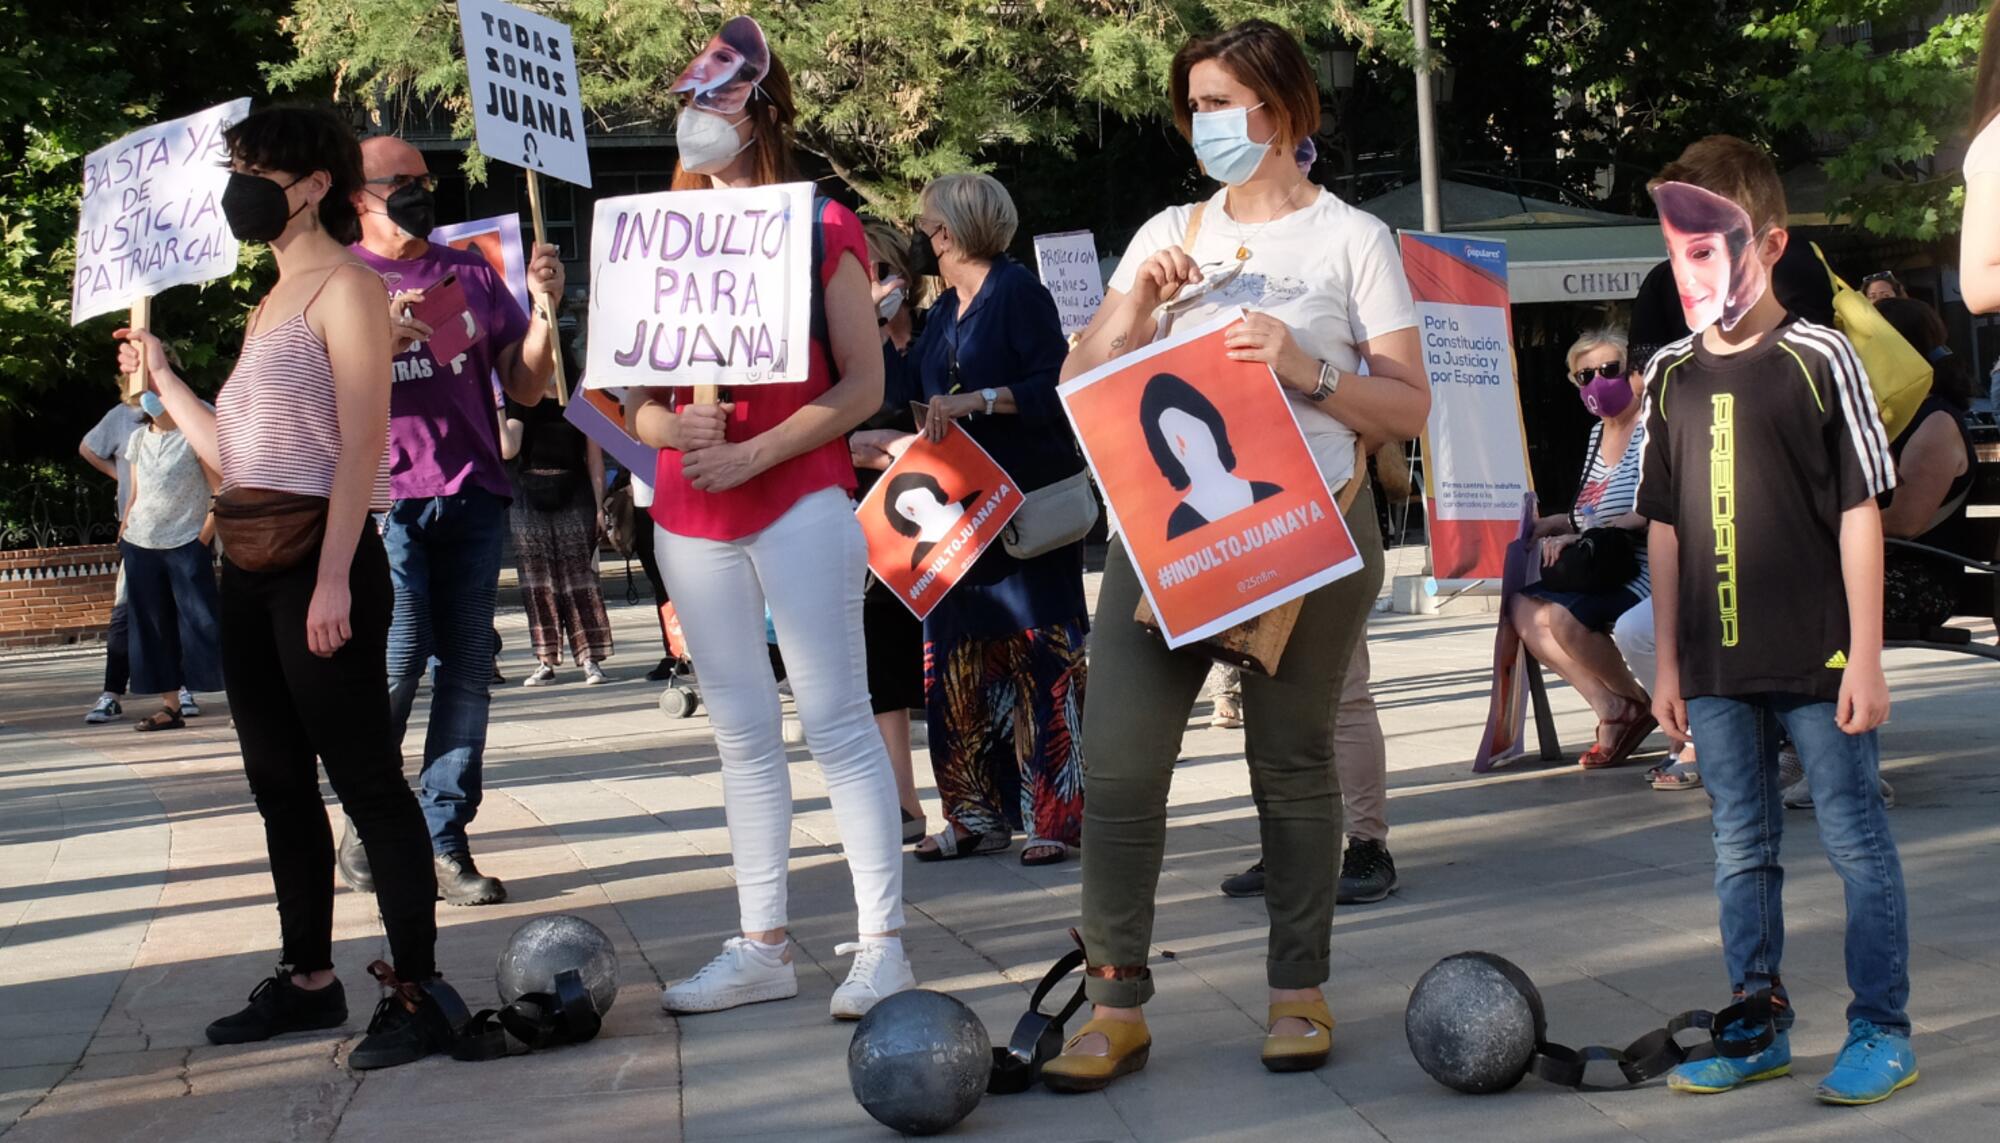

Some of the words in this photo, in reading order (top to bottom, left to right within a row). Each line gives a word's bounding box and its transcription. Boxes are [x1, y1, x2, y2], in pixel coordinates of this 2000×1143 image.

[481, 11, 562, 62] TODAS
[485, 46, 567, 96] SOMOS
[486, 81, 575, 142] JUANA
[82, 137, 169, 200] BASTA
[122, 179, 152, 212] DE
[78, 190, 218, 259] JUSTICIA
[609, 208, 786, 263] INDULTO
[77, 226, 223, 305] PATRIARCAL
[654, 266, 761, 317] PARA
[614, 319, 774, 371] JUANA
[1424, 315, 1447, 330] Por
[1448, 317, 1459, 331] la
[1428, 351, 1440, 364] la
[1443, 351, 1489, 368] Justicia
[1491, 357, 1499, 371] y
[1431, 371, 1452, 386] por
[1454, 370, 1500, 387] España
[909, 483, 1010, 600] #INDULTOJUANAYA
[1157, 500, 1325, 590] #INDULTOJUANAYA
[1710, 393, 1739, 647] PREDATOR
